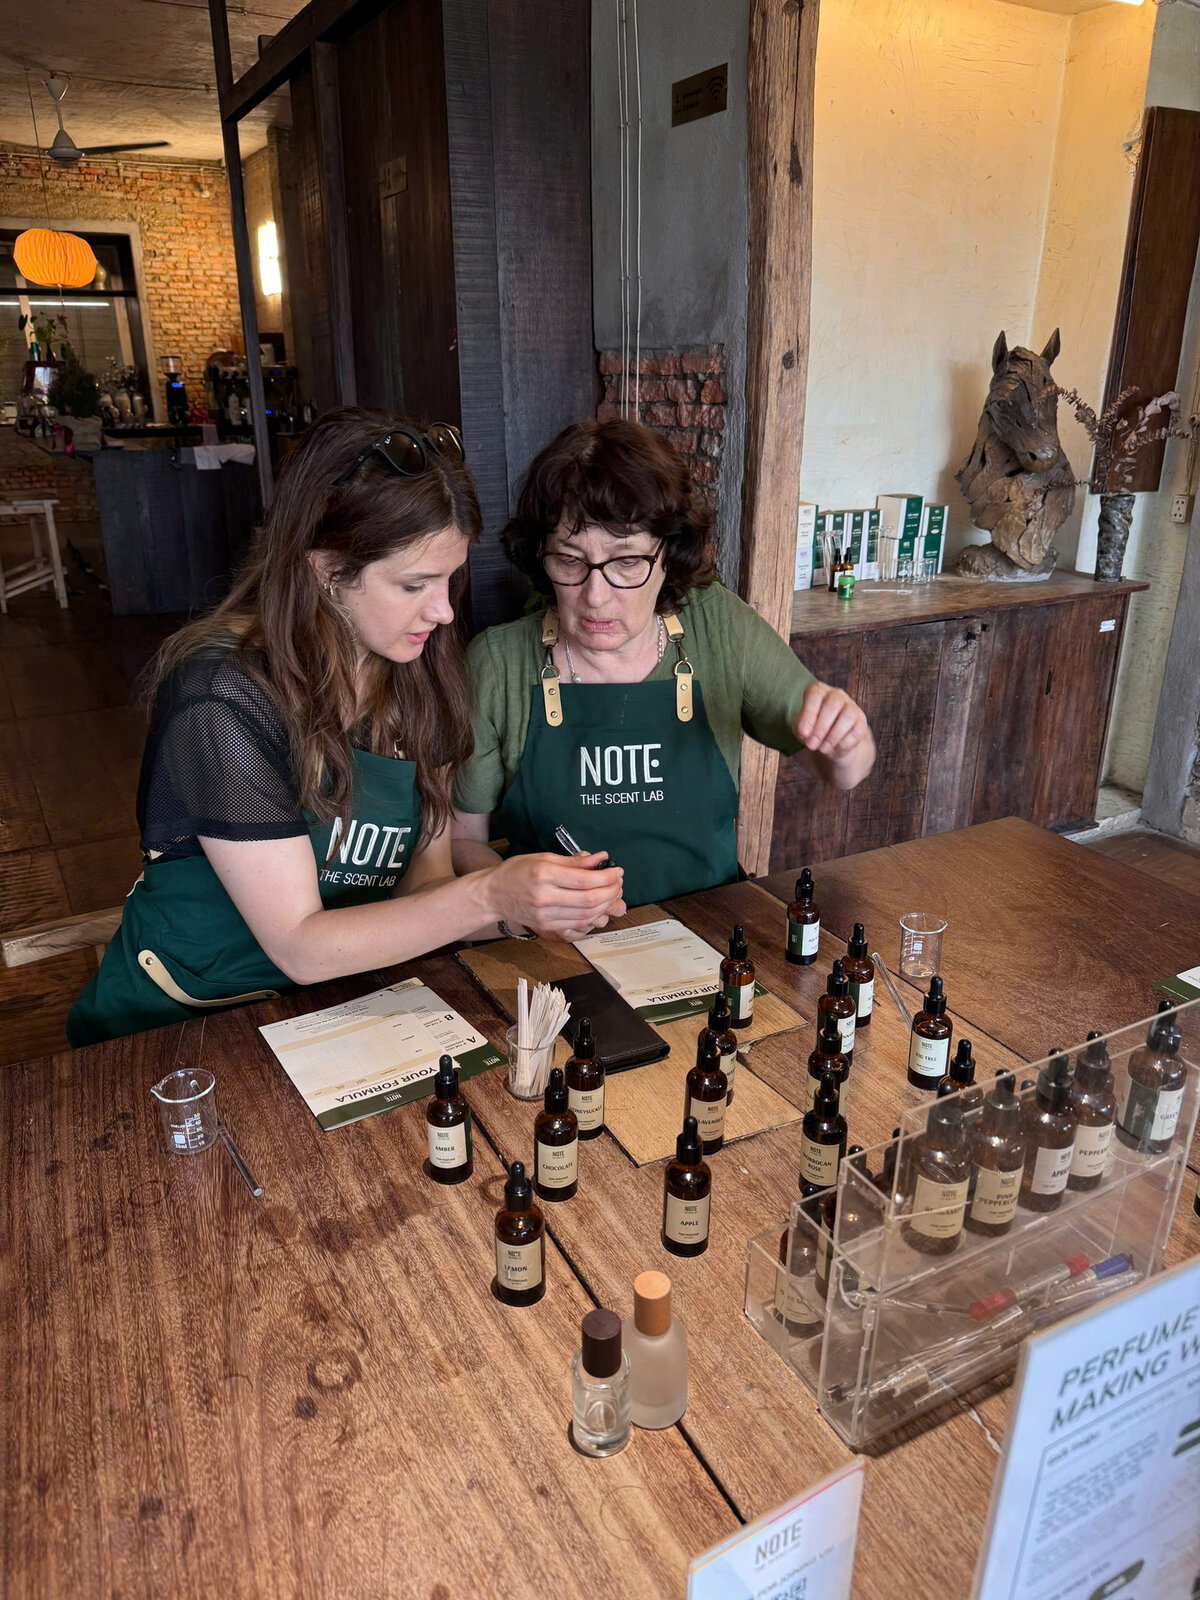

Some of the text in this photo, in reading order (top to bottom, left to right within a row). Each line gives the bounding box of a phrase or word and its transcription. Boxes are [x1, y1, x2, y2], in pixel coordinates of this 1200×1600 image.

[580, 743, 664, 787] NOTE
[580, 790, 664, 804] THE SCENT LAB
[325, 816, 411, 868] NOTE
[319, 869, 399, 887] THE SCENT LAB
[647, 989, 698, 1003] FORMULA
[699, 984, 719, 993] OUR
[466, 1036, 476, 1044] A
[401, 1067, 439, 1084] YOUR
[335, 1081, 400, 1103] FORMULA
[542, 1162, 573, 1171] CHOCOLATE
[803, 1151, 832, 1167] MORROCAN
[808, 1163, 821, 1172] ROSE
[504, 1264, 527, 1272] LEMON
[1058, 1304, 1200, 1398] PERFUME
[1049, 1349, 1171, 1433] MAKING
[755, 1518, 804, 1566] NOTE
